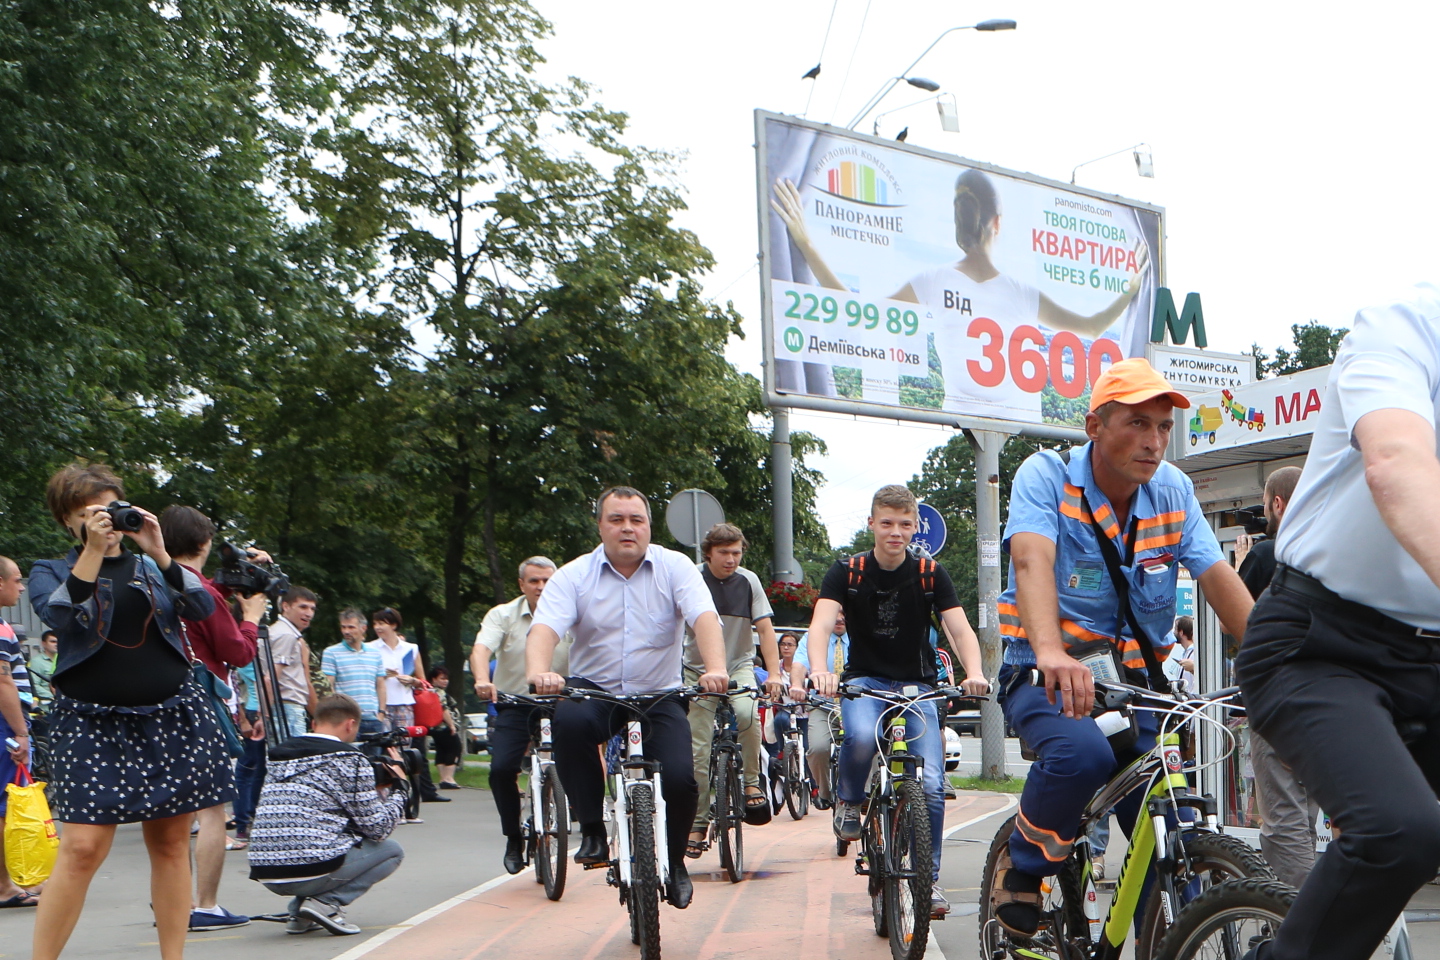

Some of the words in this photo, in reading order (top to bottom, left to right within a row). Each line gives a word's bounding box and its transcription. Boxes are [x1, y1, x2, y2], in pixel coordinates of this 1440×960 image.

[815, 199, 903, 233] ПАНОРАМНЕ
[1055, 197, 1112, 218] panomisto.com
[831, 225, 889, 246] МІСТЕЧКО
[1043, 210, 1077, 231] ТВОЯ
[1080, 219, 1126, 243] ГОТОВА
[1032, 228, 1139, 274] КВАРТИРА
[1044, 262, 1085, 285] ЧЕРЕЗ
[1089, 268, 1100, 289] 6
[784, 290, 838, 324] 229
[845, 299, 879, 330] 99
[886, 306, 919, 336] 89
[943, 288, 972, 316] Від
[1150, 286, 1208, 348] М
[808, 335, 886, 360] Деміївська
[1169, 357, 1239, 375] ЖИТОМИРСЬКА
